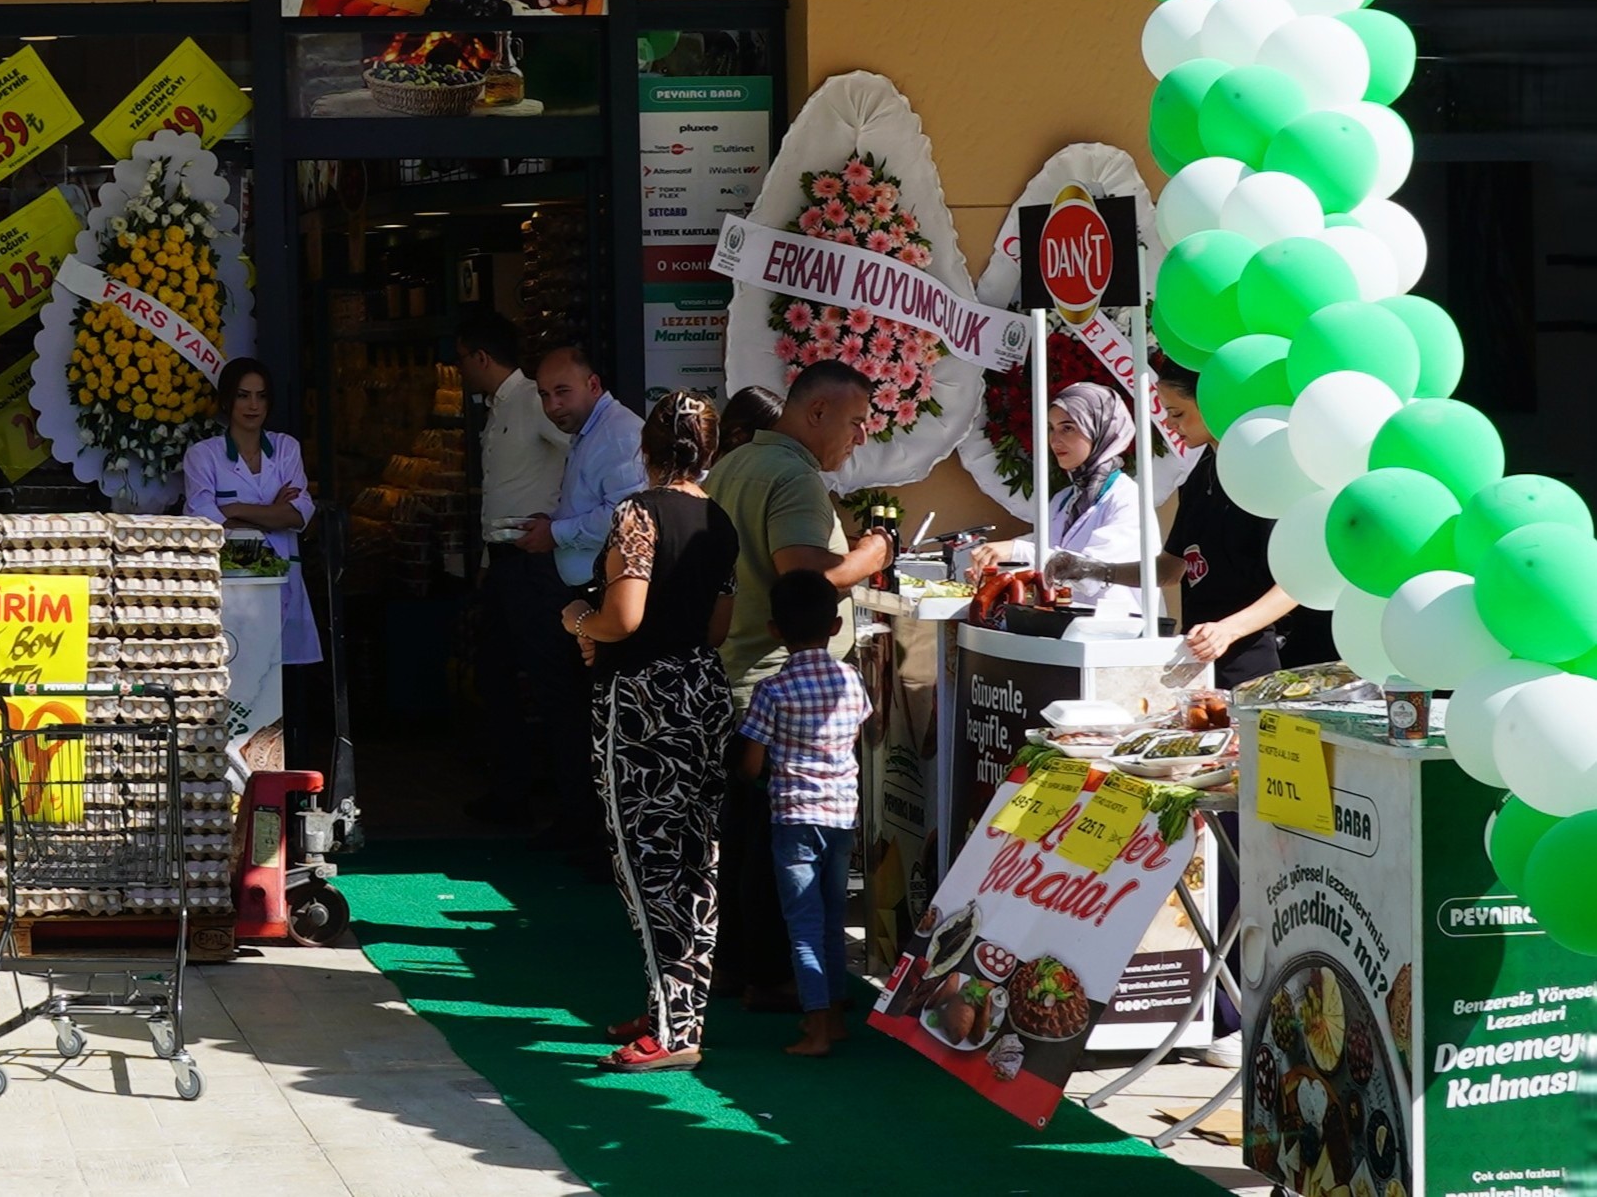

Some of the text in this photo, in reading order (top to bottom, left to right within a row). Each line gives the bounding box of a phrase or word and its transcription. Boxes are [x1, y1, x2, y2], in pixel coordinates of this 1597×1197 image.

[128, 75, 173, 116] YÖRETÜRK
[129, 76, 186, 131] TAZE DEM ÇAYI
[679, 123, 719, 134] pluxee
[648, 207, 687, 218] SETCARD
[762, 240, 845, 296] ERKAN
[661, 317, 708, 327] LEZZET
[851, 259, 991, 356] KUYUMCULUK
[103, 282, 221, 375] FARS YAPI
[654, 329, 723, 343] Markalar
[971, 674, 1028, 719] Güvenle,
[966, 709, 1012, 754] keyifle,
[1028, 800, 1044, 814] TL
[1266, 777, 1301, 801] 210 TL
[1077, 817, 1107, 839] 225 TL
[1334, 804, 1372, 841] BABA
[1266, 864, 1391, 962] Eşsiz yöresel lezzetlerimizi
[1271, 890, 1389, 999] denediniz mi?
[1453, 990, 1535, 1015] Benzersiz
[1486, 1005, 1567, 1030] Lezzetleri
[1434, 1032, 1589, 1074] Denemey
[1472, 1171, 1494, 1184] Çok
[1496, 1170, 1524, 1181] daha
[1525, 1168, 1560, 1180] fazlası
